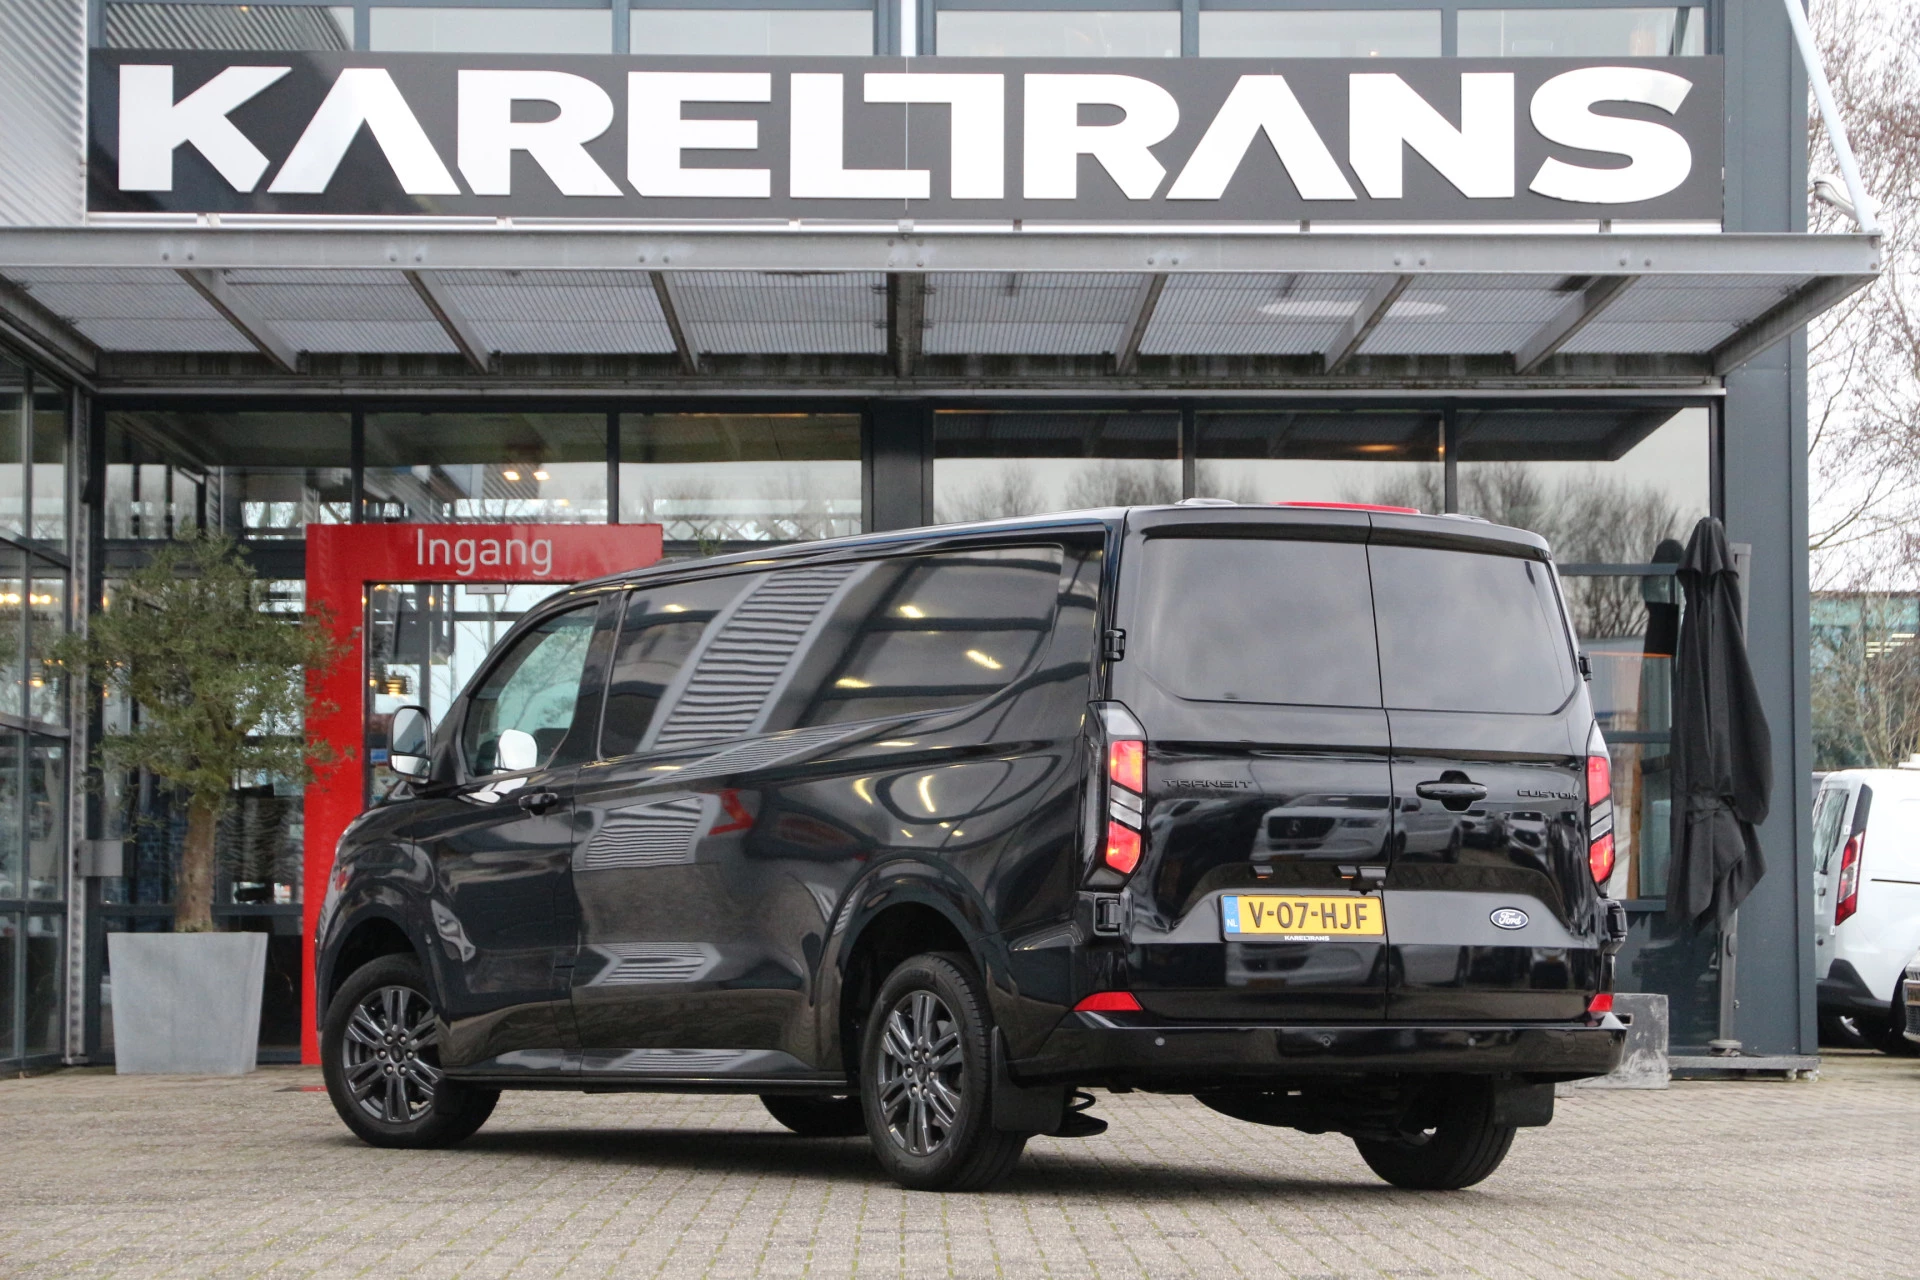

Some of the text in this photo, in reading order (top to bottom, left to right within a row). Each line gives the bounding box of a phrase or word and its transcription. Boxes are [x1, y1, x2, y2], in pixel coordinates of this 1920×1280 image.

[118, 64, 1694, 204] KARELTRANS
[416, 528, 552, 576] Ingang
[1161, 779, 1252, 788] TRANSIT
[1517, 789, 1579, 800] CUSTOM
[1248, 901, 1368, 929] V-07-HJF
[1498, 911, 1522, 925] Ford
[1226, 918, 1239, 928] NL
